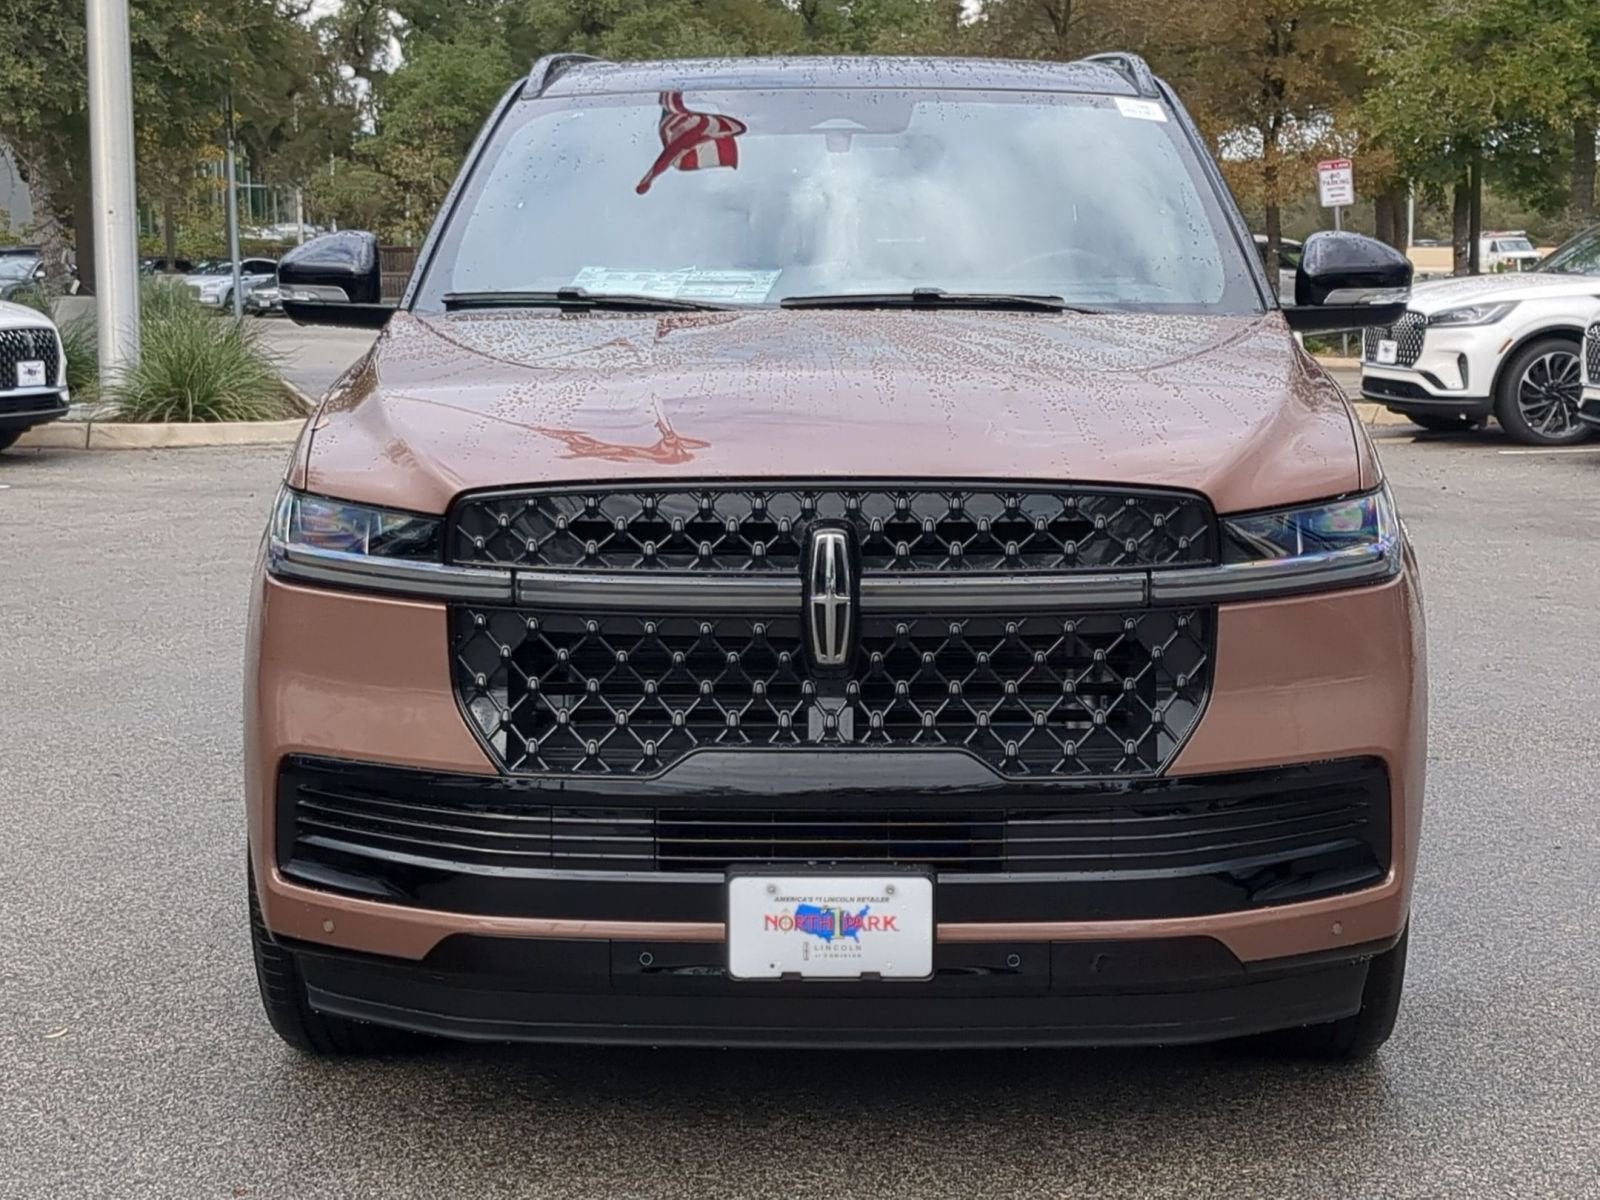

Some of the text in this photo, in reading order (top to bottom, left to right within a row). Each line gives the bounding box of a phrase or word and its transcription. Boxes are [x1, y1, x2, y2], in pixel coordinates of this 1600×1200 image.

[1322, 178, 1350, 186] PARKING
[764, 915, 832, 932] NORTH
[843, 915, 899, 932] PARK
